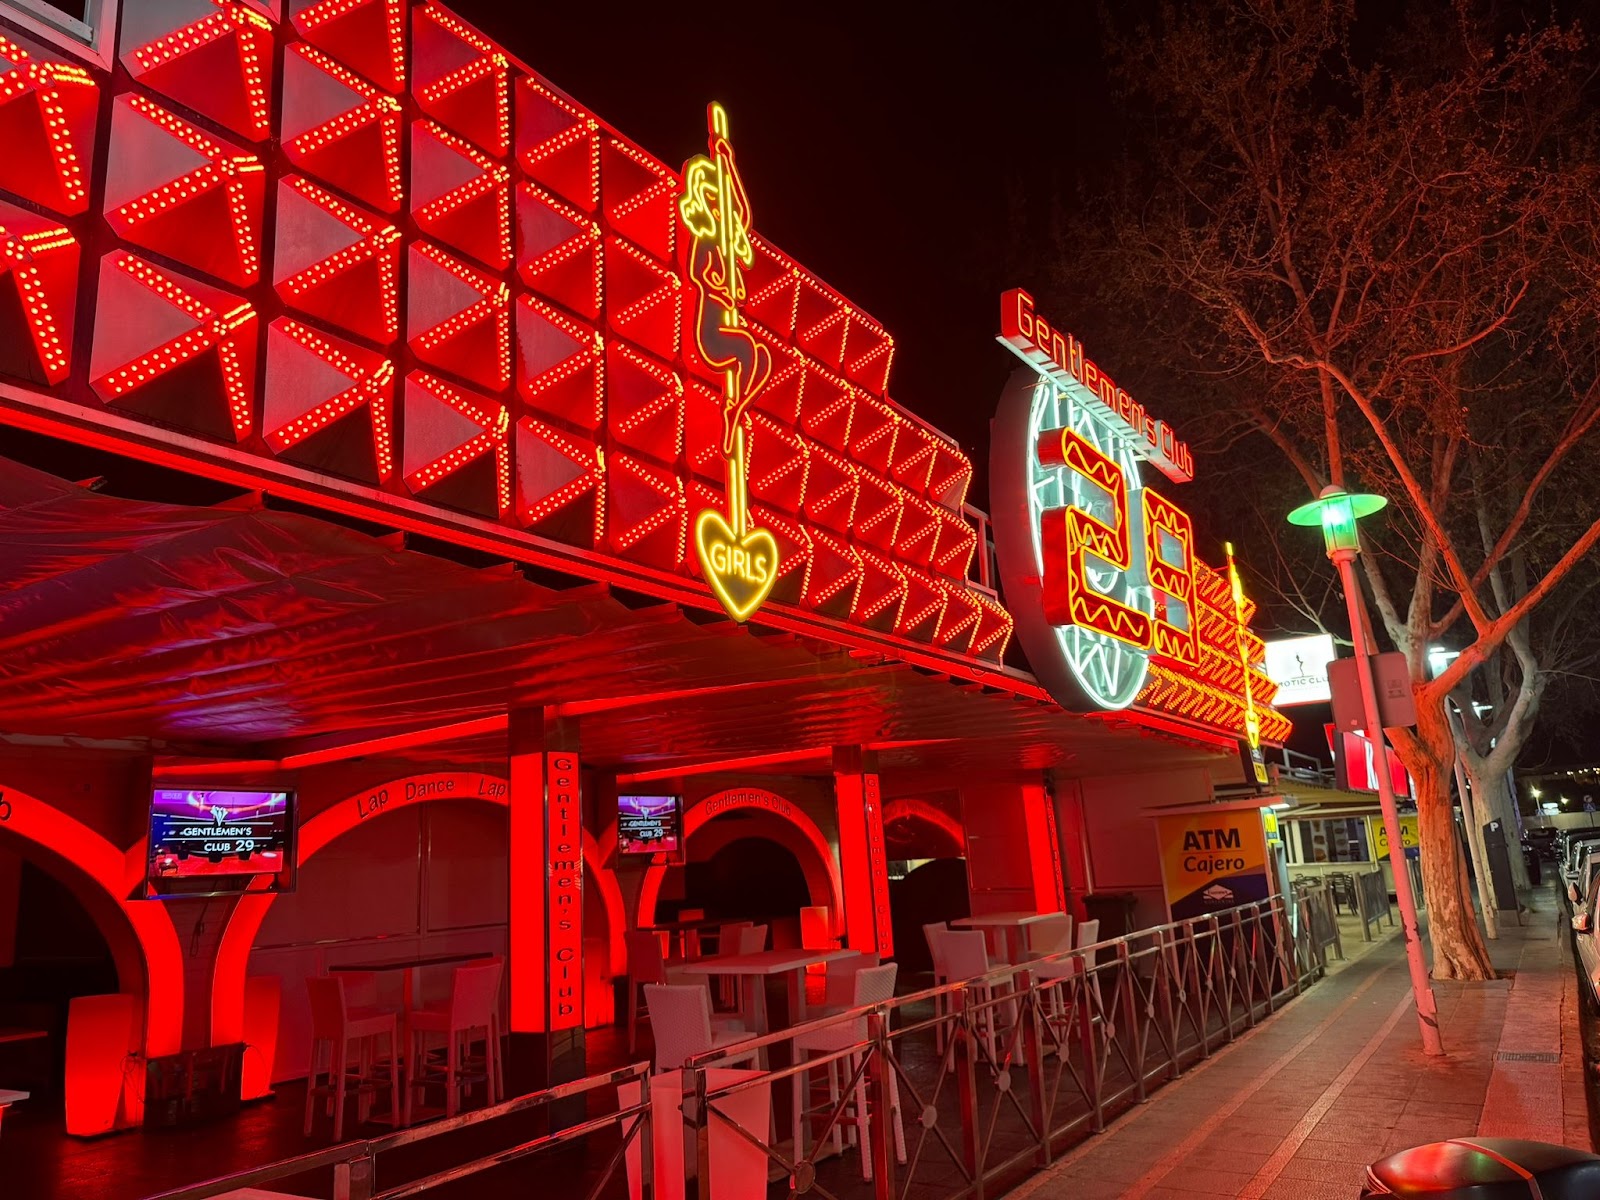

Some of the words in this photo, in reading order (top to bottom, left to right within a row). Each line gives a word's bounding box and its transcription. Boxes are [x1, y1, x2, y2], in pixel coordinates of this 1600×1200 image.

[1015, 288, 1158, 449] Gentlemen's
[1159, 420, 1194, 480] Club
[1061, 426, 1201, 668] 29
[709, 541, 768, 583] GIRLS
[1278, 678, 1307, 688] ROTIC
[356, 788, 389, 819] Lap
[405, 779, 455, 801] Dance
[478, 778, 507, 797] Lap
[705, 791, 769, 816] Gentlemen's
[771, 795, 792, 817] Club
[183, 826, 253, 837] GENTLEMEN'S
[653, 828, 664, 838] 29
[1183, 827, 1241, 851] ATM
[1379, 825, 1409, 836] AM
[1489, 821, 1499, 833] P
[203, 842, 231, 852] CLUB
[234, 839, 255, 852] 29
[553, 758, 576, 931] Gentlemen's
[1183, 854, 1245, 875] Cajero
[555, 947, 575, 1017] Club
